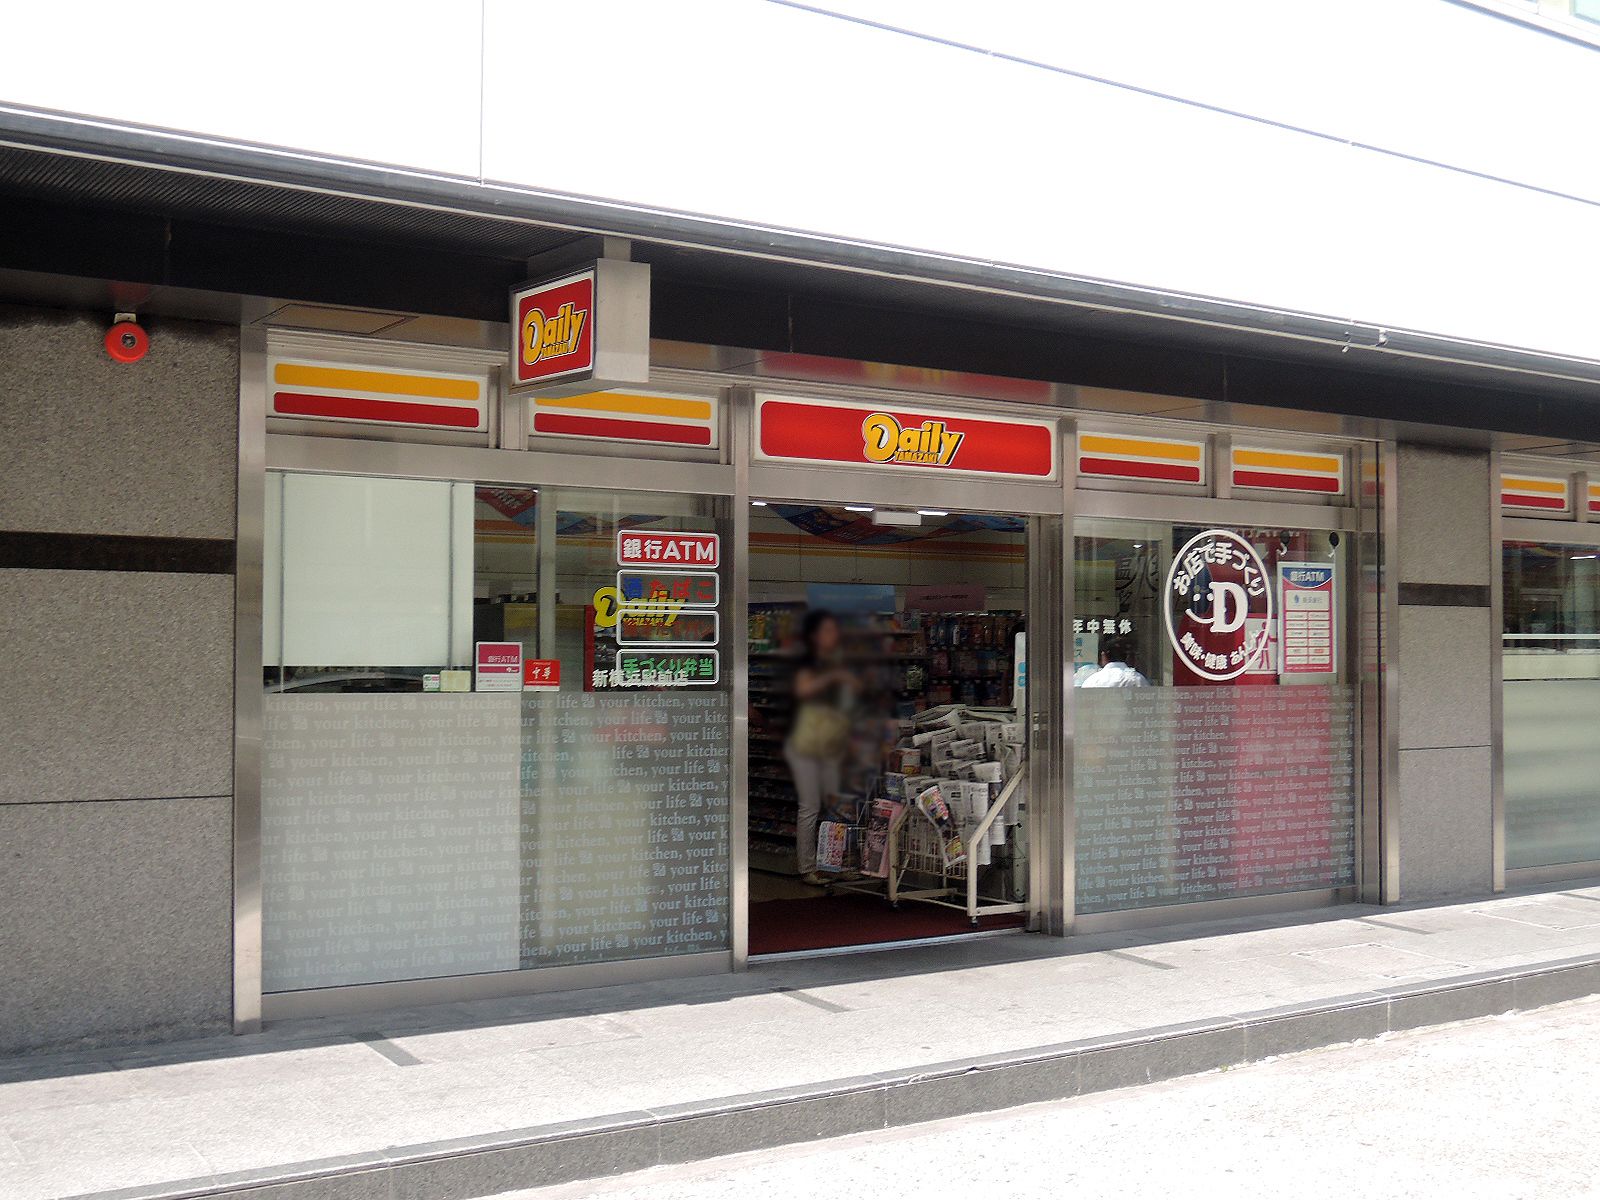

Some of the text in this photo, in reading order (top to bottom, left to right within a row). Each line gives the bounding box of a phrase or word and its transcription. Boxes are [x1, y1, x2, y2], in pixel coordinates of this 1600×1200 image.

[523, 302, 587, 365] Daily
[863, 413, 964, 465] Daily
[894, 450, 939, 464] YAMAZAKI
[623, 538, 714, 561] 銀行ATM
[1173, 539, 1265, 596] お店で手づくり
[1209, 581, 1248, 633] D
[556, 694, 578, 708] life
[599, 698, 629, 711] your
[687, 697, 716, 710] your
[672, 714, 701, 727] your
[669, 731, 699, 744] your
[702, 726, 722, 740] life
[611, 744, 633, 759] life
[653, 748, 683, 761] your
[651, 765, 680, 778] your
[684, 759, 704, 774] life
[634, 782, 664, 796] your
[632, 799, 662, 813] your
[665, 793, 686, 808] life
[647, 828, 668, 843] life
[688, 830, 717, 844] your
[685, 847, 714, 861] your
[669, 865, 699, 879] your
[667, 881, 697, 896] your
[700, 875, 720, 890] life
[651, 899, 681, 914] your
[649, 916, 679, 931] your
[682, 909, 702, 925] life
[555, 941, 587, 957] your
[590, 934, 612, 950] life
[633, 935, 663, 950] your
